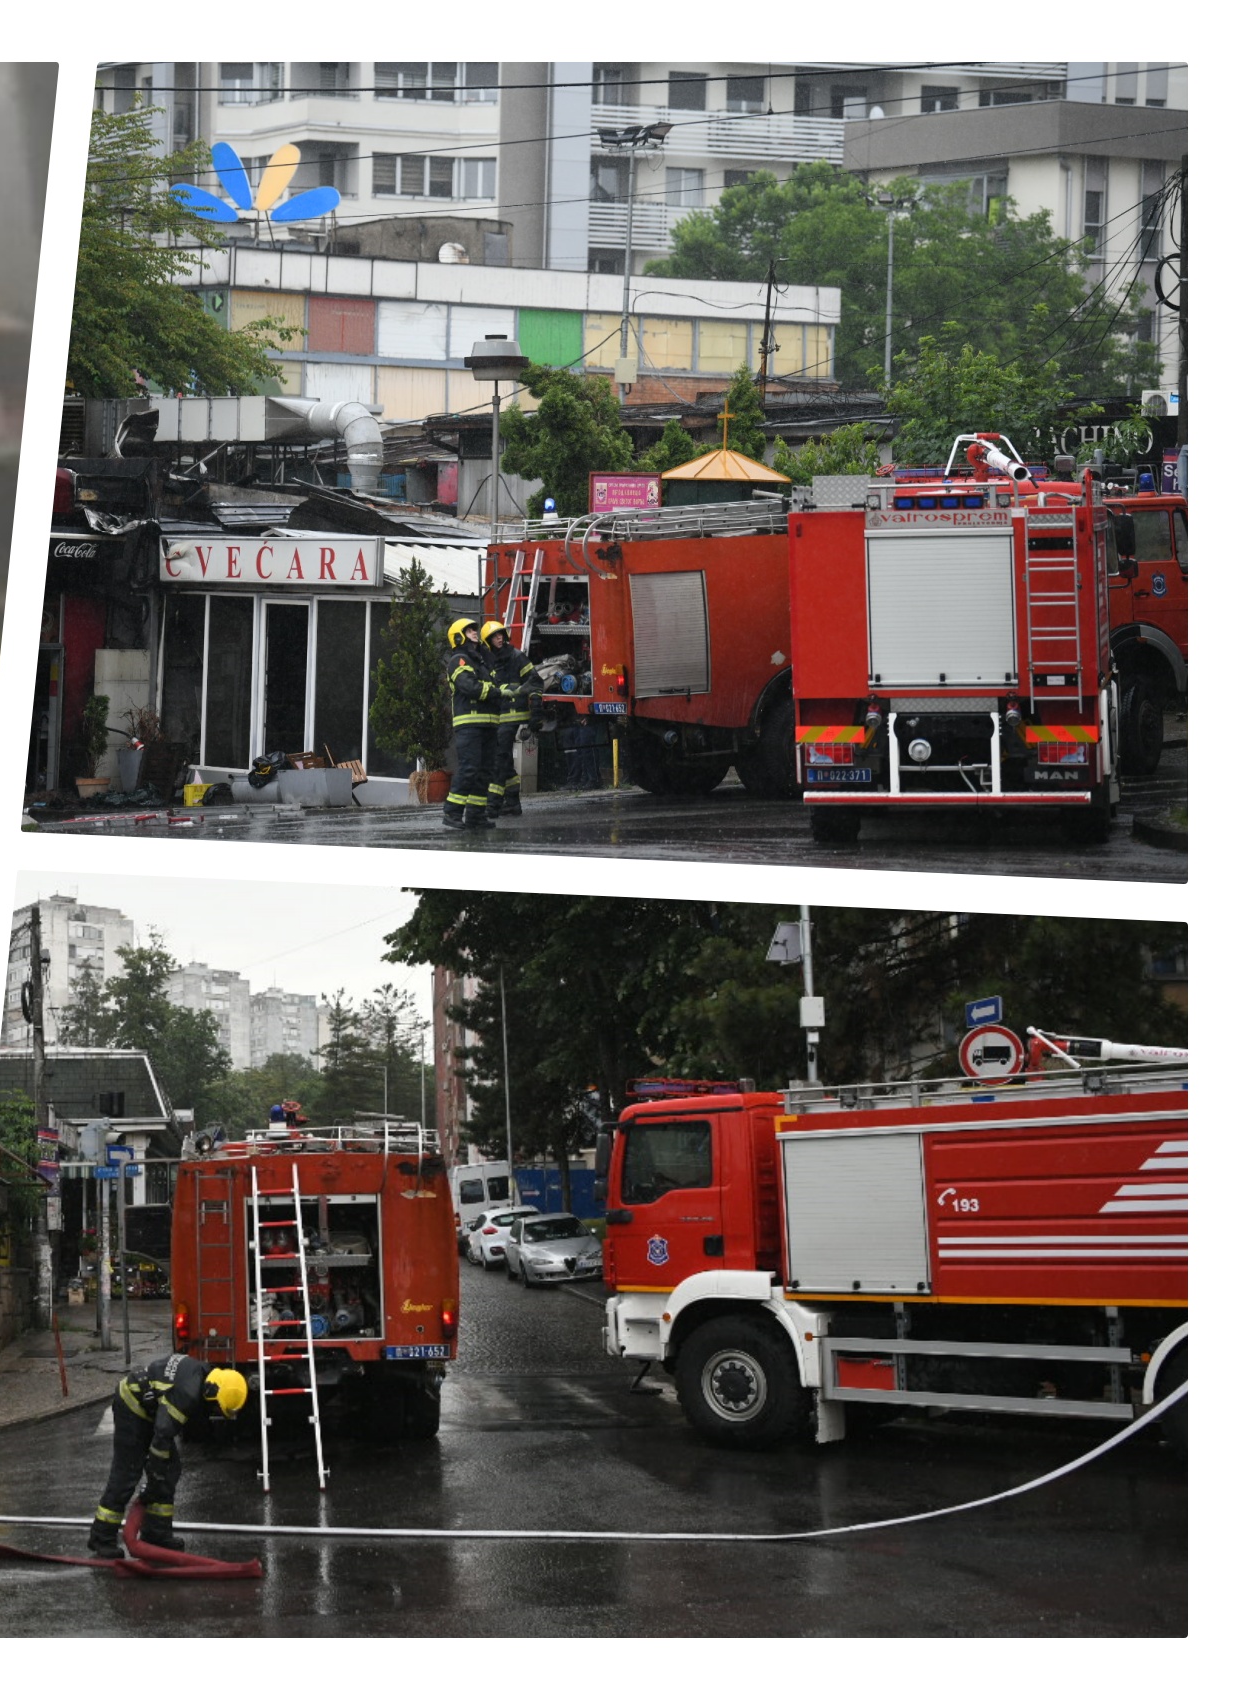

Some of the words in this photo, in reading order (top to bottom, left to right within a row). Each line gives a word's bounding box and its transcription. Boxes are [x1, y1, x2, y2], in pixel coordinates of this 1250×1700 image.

[53, 541, 99, 559] Coca-Cola
[829, 770, 866, 781] 022-371
[1034, 771, 1079, 780] MAN
[951, 1198, 980, 1212] 193
